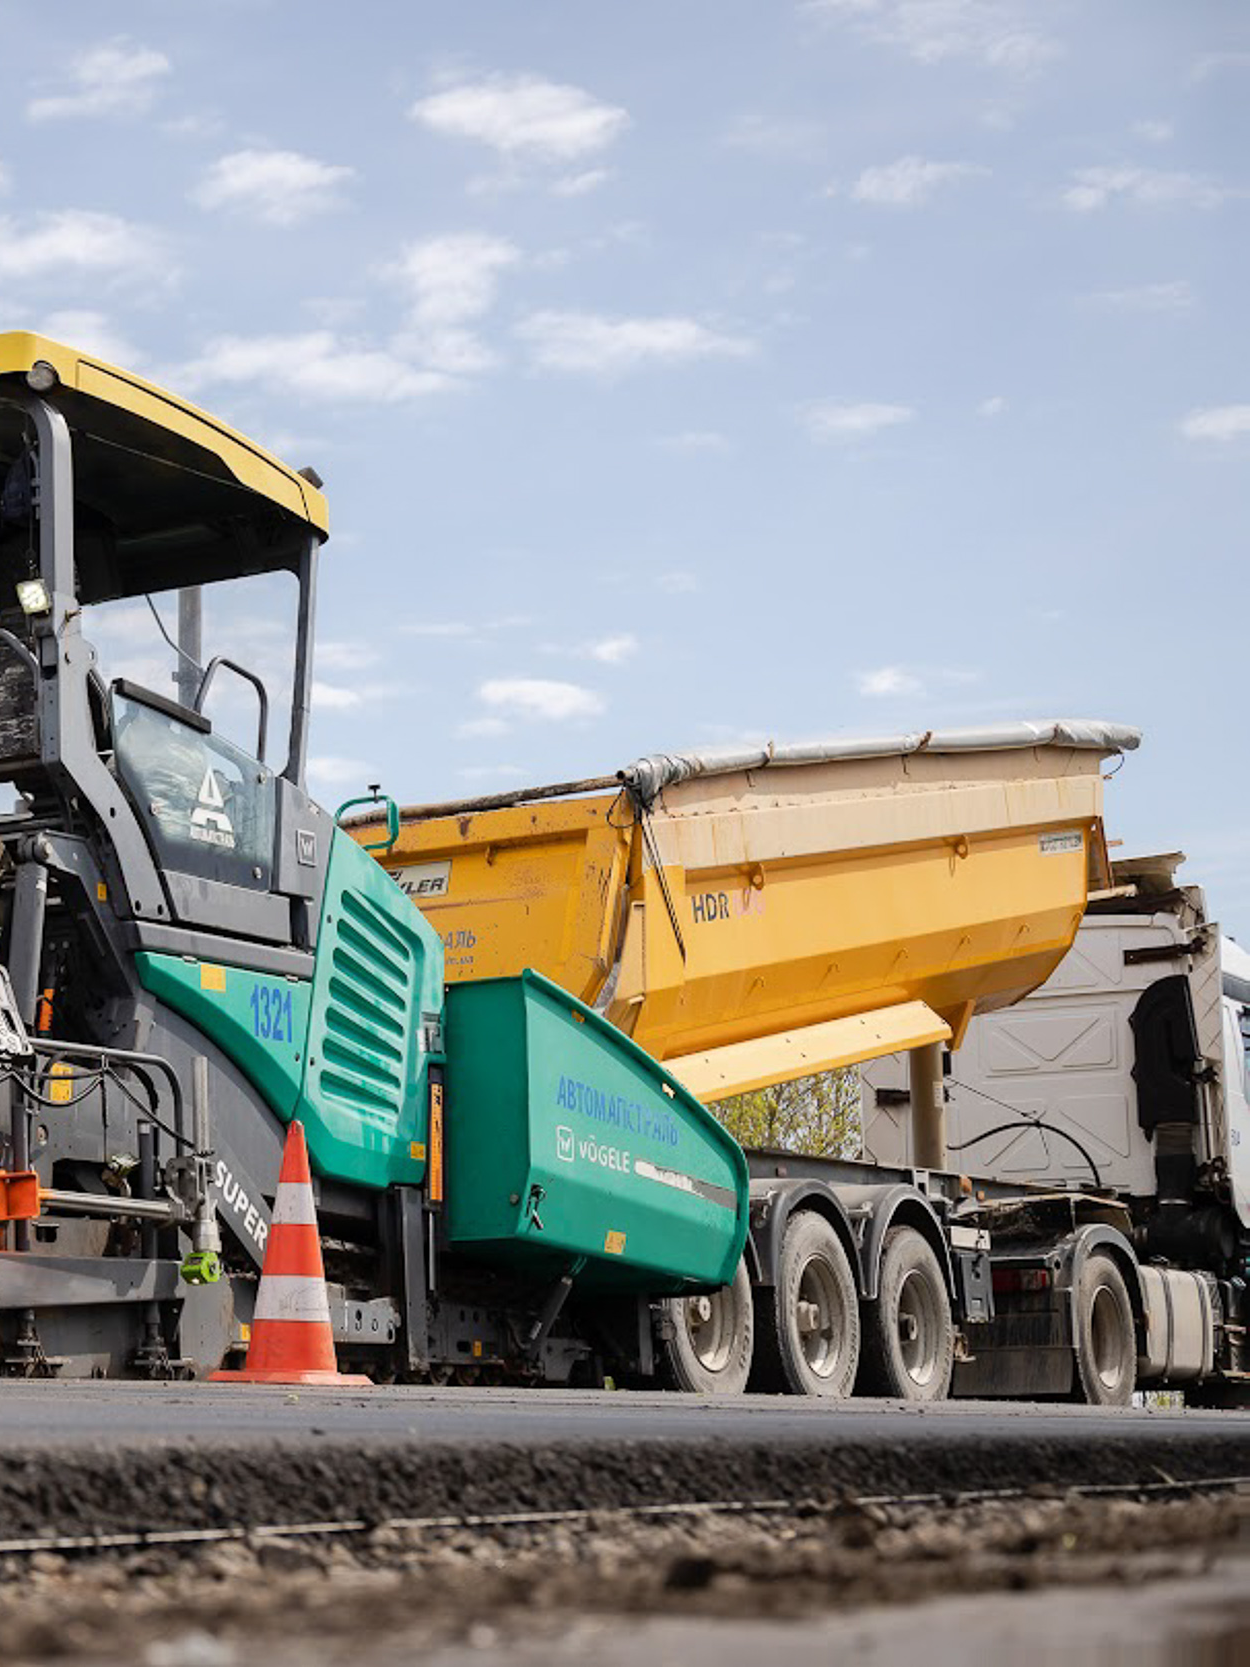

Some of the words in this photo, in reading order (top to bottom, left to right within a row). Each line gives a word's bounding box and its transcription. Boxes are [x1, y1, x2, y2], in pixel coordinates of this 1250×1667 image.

[691, 891, 730, 924] HDR
[250, 982, 293, 1044] 1321
[579, 1134, 631, 1174] VÖGELE
[215, 1160, 268, 1251] SUPER
